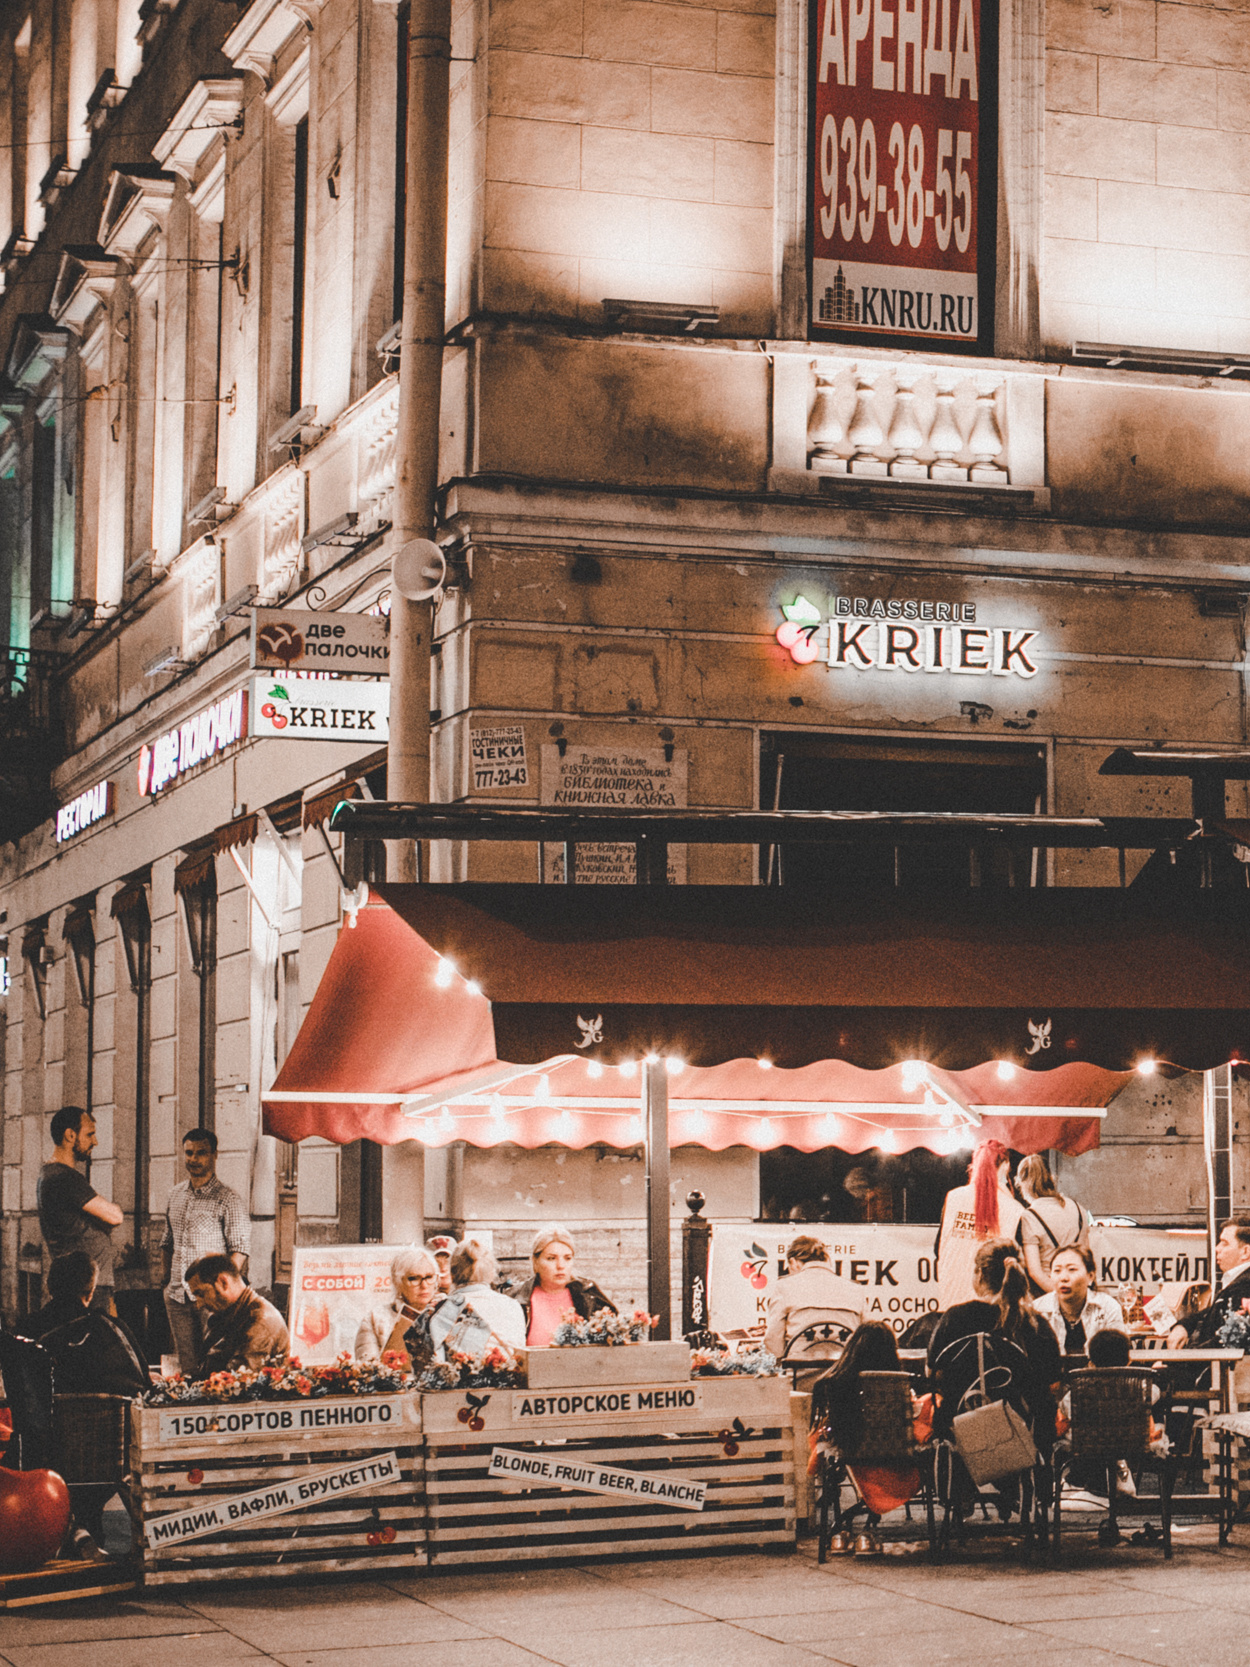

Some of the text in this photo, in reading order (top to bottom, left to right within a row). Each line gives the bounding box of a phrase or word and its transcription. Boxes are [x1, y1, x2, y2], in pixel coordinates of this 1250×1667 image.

[818, 0, 979, 101] АРЕНДА
[819, 113, 972, 254] 939-38-55
[860, 285, 974, 336] KNRU.RU
[834, 597, 977, 623] BRASSERIE
[305, 623, 346, 639] две
[832, 620, 1039, 677] KRIEK
[289, 706, 377, 730] KRIEK
[472, 745, 525, 760] ЧЕКИ
[475, 768, 527, 788] 777-23-43
[56, 779, 109, 843] РЕСТОРАН
[303, 1275, 364, 1289] С СОБОЙ
[520, 1389, 696, 1416] АВТОРСКОЕ МЕНЮ
[171, 1403, 392, 1435] 150 СОРТОВ ПЕННОГО
[492, 1454, 705, 1503] BLONDE, FRUIT BEER, BLANCHE
[153, 1460, 394, 1541] МИДИИ, ВАФЛИ, БРУСКЕТТЫ
